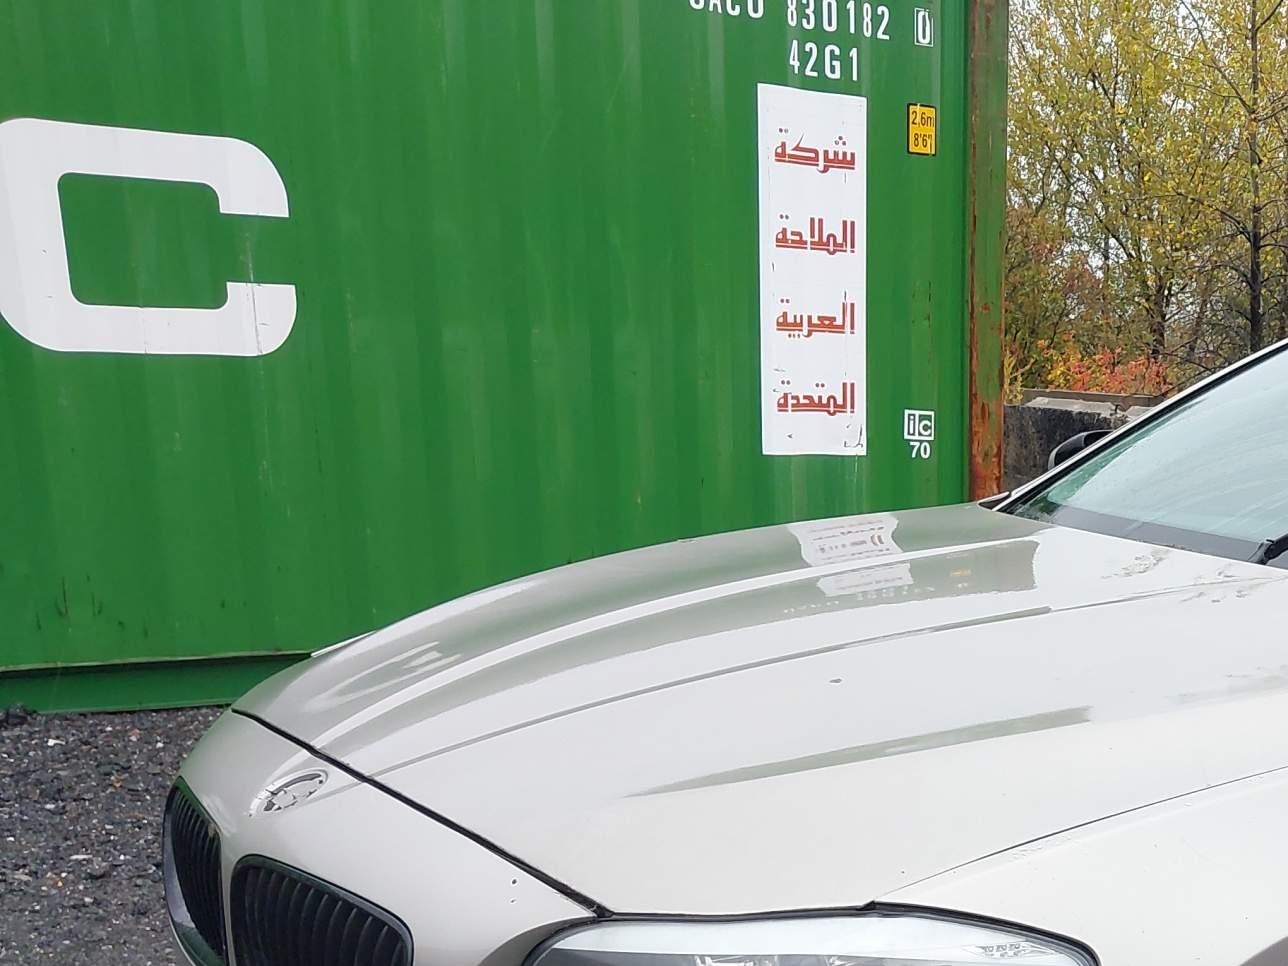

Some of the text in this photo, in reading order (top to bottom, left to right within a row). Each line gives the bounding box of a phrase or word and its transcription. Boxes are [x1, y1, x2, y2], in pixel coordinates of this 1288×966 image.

[787, 0, 890, 40] 830182
[789, 39, 858, 81] 42G1
[774, 127, 856, 174] شركة
[775, 213, 856, 256] الملاحة
[775, 297, 856, 338] العربية
[776, 379, 856, 417] المتحدة
[909, 441, 931, 459] 70
